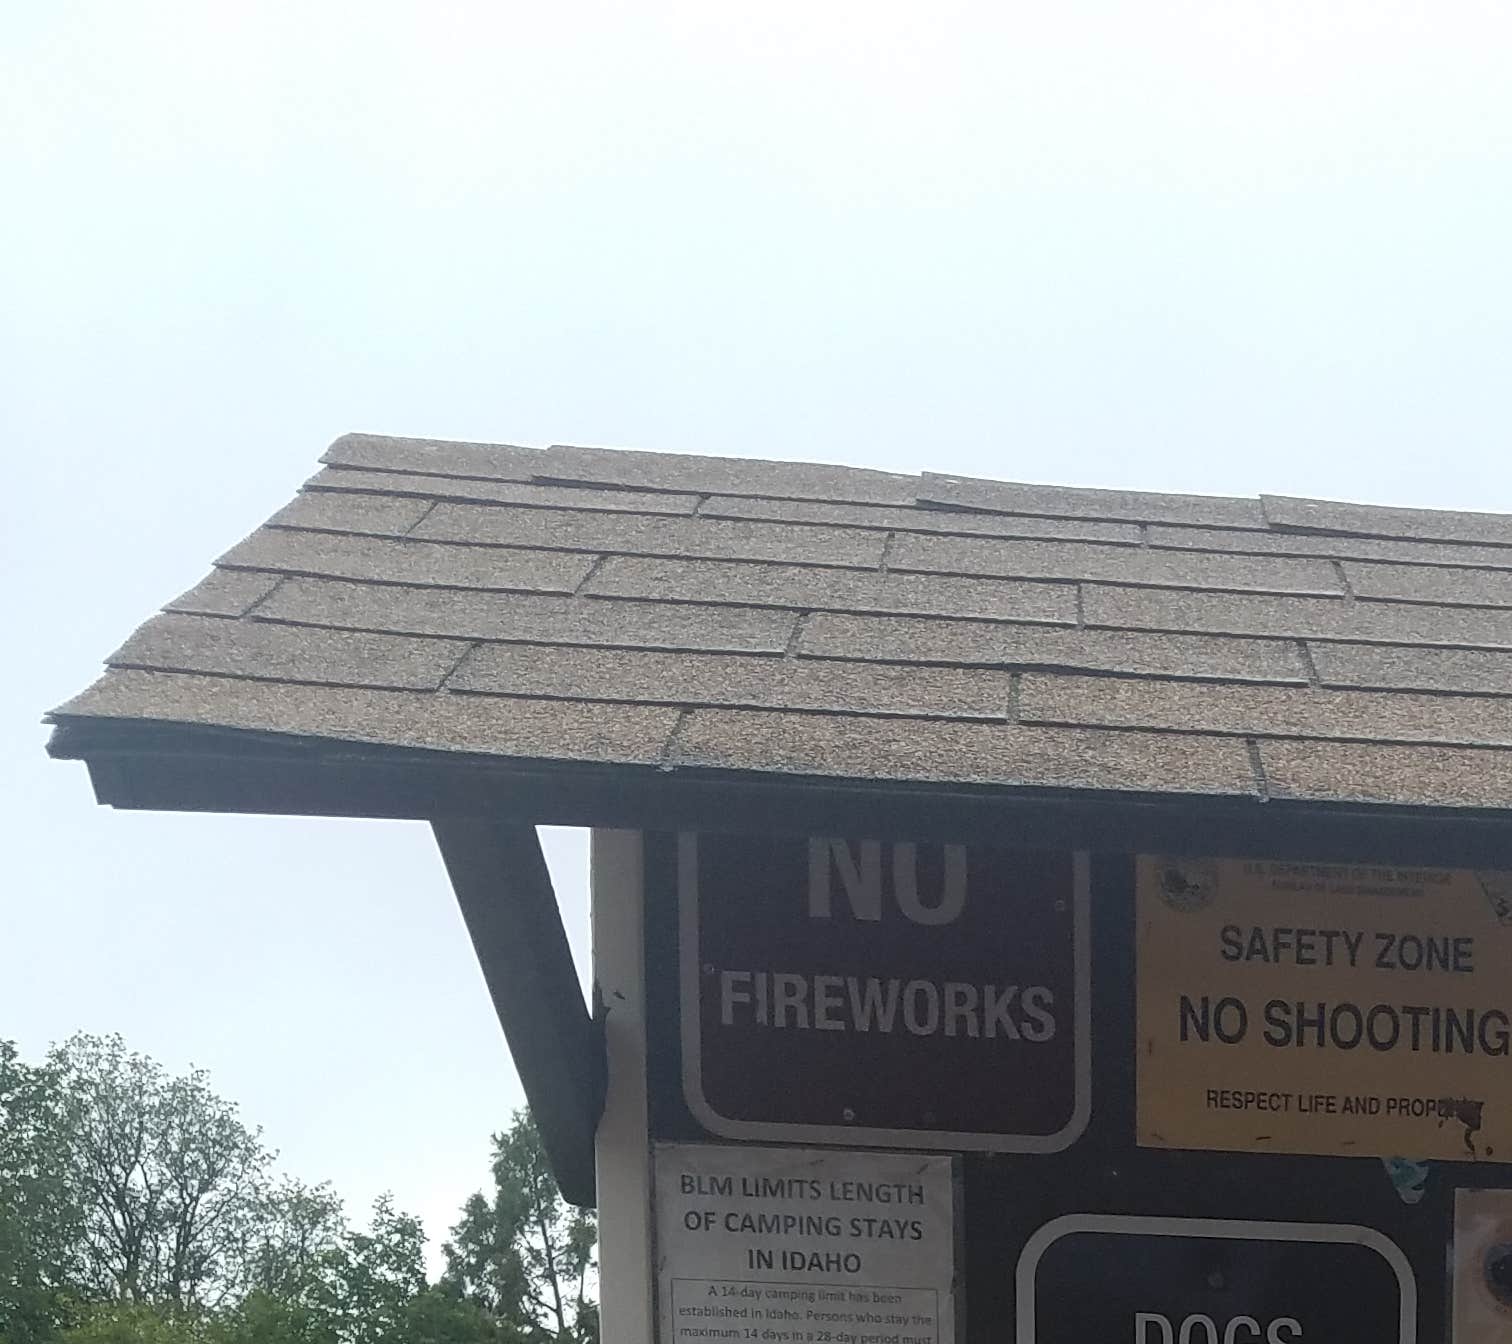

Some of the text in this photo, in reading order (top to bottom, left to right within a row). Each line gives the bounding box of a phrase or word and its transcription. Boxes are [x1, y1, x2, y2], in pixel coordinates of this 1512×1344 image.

[1220, 924, 1474, 973] SAFETY ZONE
[720, 969, 1055, 1041] FIREWORKS
[1180, 995, 1510, 1056] NO SHOOTING
[1207, 1089, 1293, 1112] RESPECT
[1298, 1094, 1337, 1114] LIFE
[1341, 1096, 1381, 1115] AND
[681, 1174, 924, 1205] BLM LIMITS LENGTH
[684, 1211, 922, 1240] OF CAMPING STAYS
[748, 1249, 861, 1273] IN IDAHO
